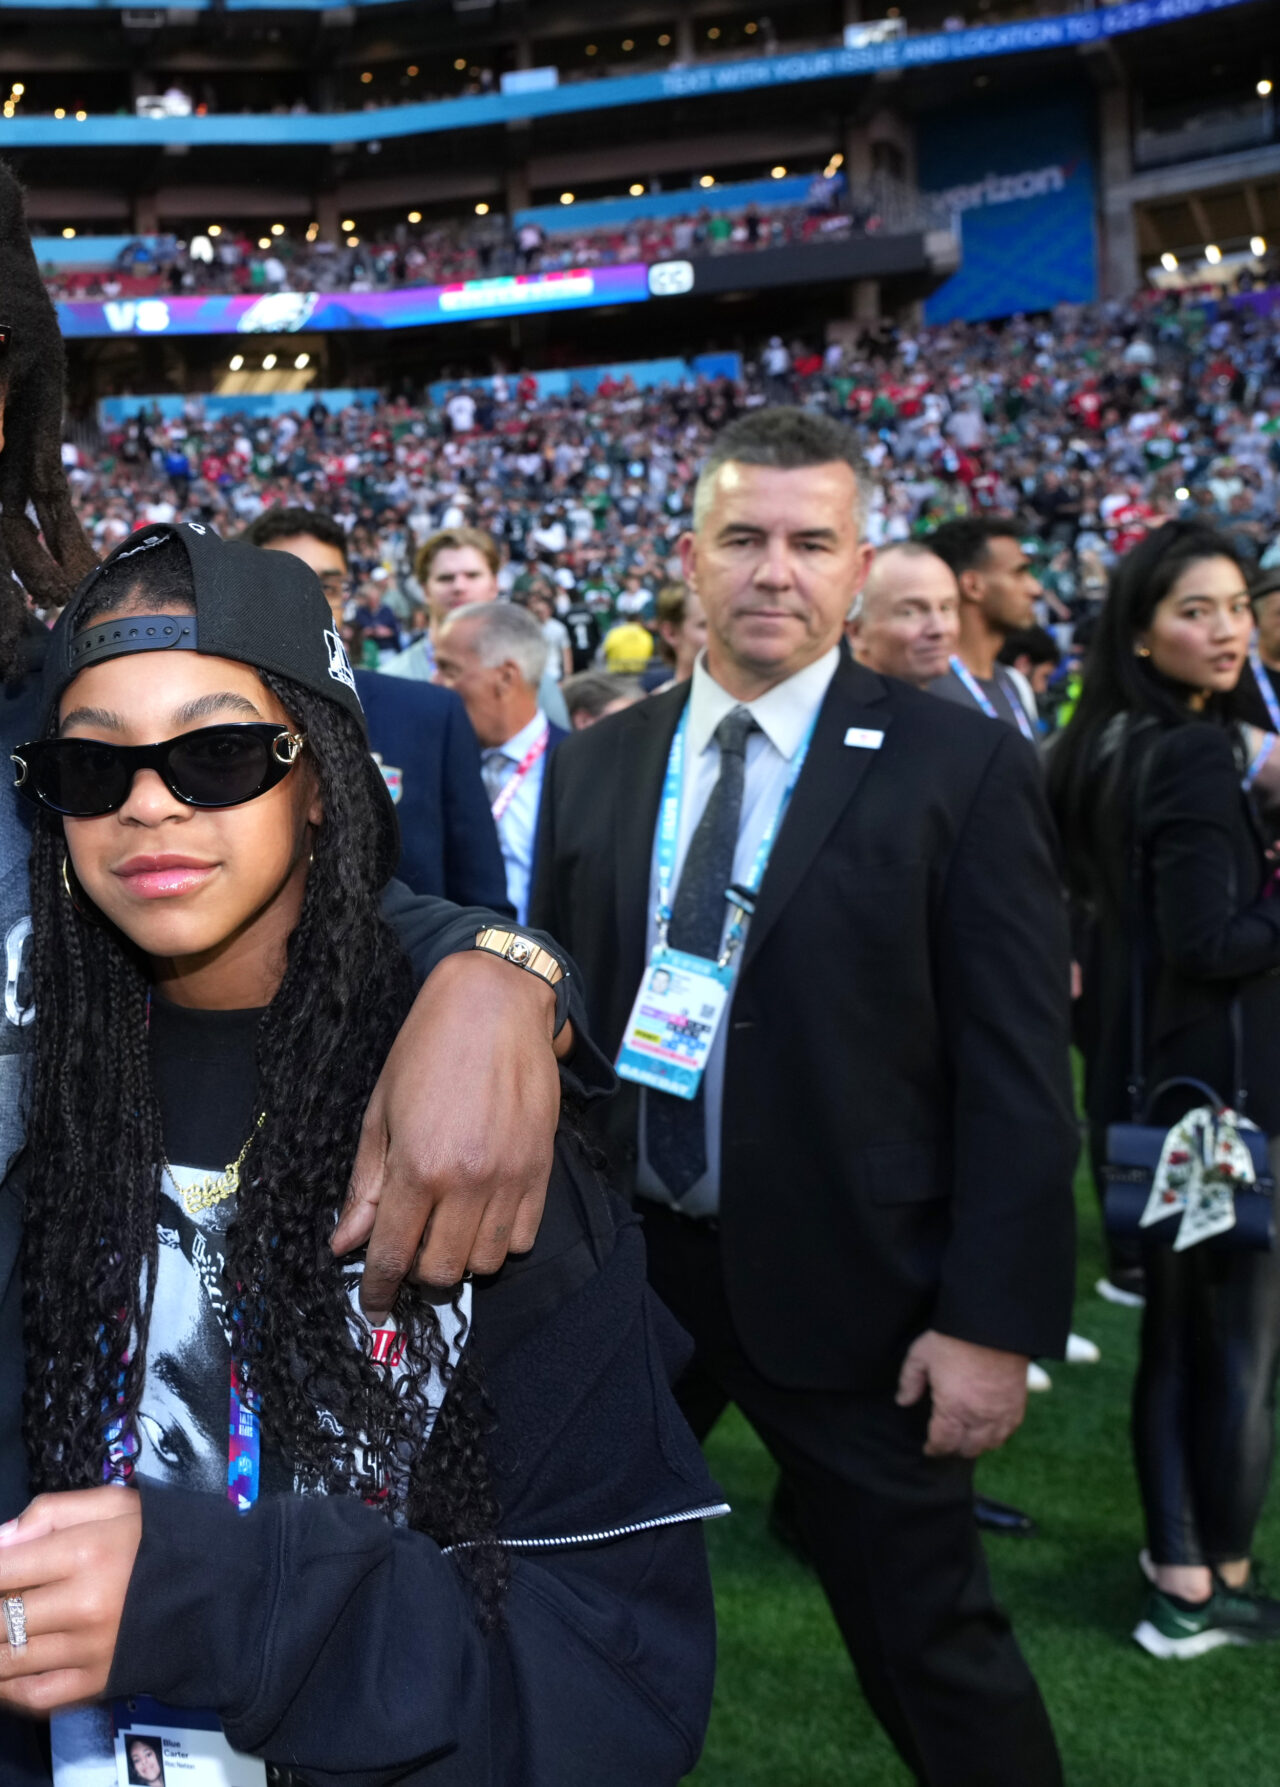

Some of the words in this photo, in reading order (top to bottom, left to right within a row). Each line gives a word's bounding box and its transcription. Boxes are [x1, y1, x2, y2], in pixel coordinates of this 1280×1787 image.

[103, 301, 170, 332] VS
[163, 1739, 181, 1748] Blue
[164, 1750, 189, 1758] Carter
